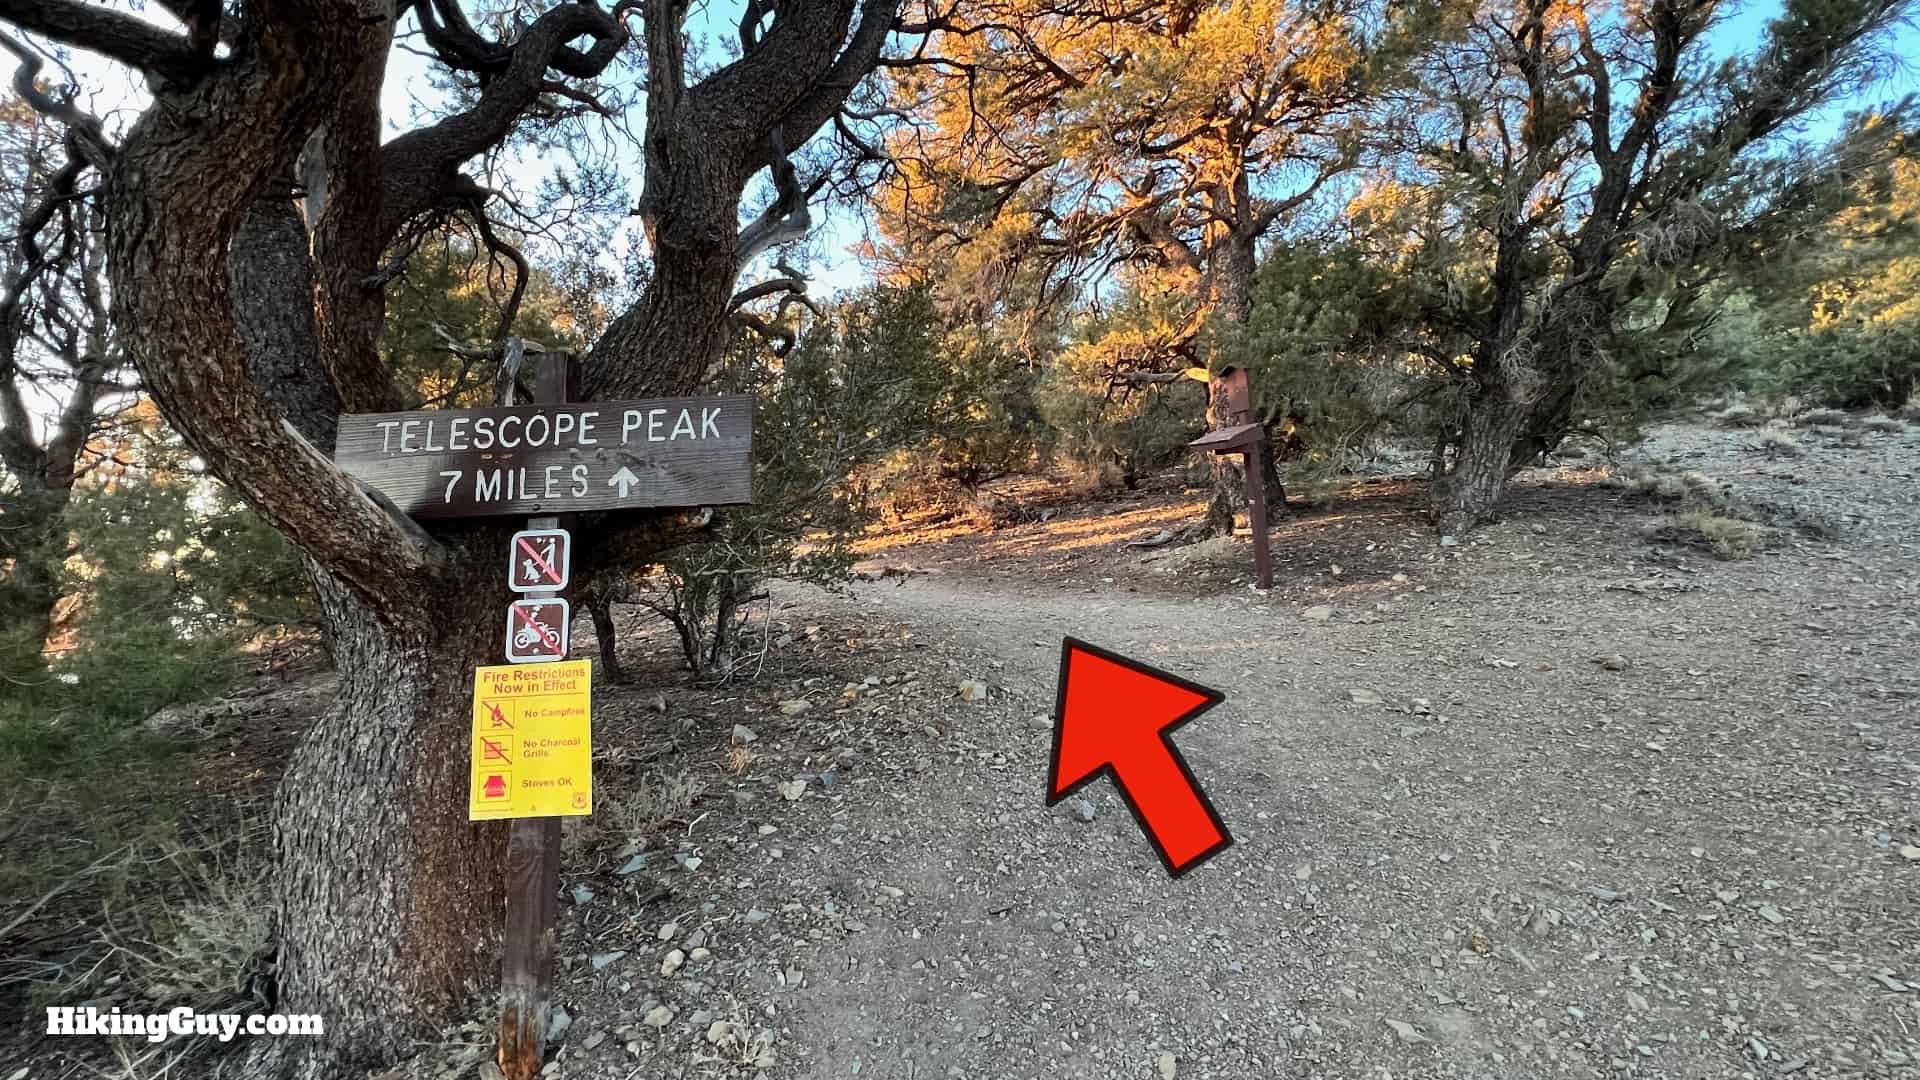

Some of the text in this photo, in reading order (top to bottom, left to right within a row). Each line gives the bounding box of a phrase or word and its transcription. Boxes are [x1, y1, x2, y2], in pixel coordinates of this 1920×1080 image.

[377, 407, 722, 453] TELESCOPE PEAK
[439, 464, 588, 503] 7 MILES
[483, 667, 585, 683] Fire Restrictions
[494, 680, 577, 694] Now in Effect
[524, 709, 538, 718] No
[523, 737, 580, 748] No Charcoal
[522, 777, 573, 788] Stoves OK
